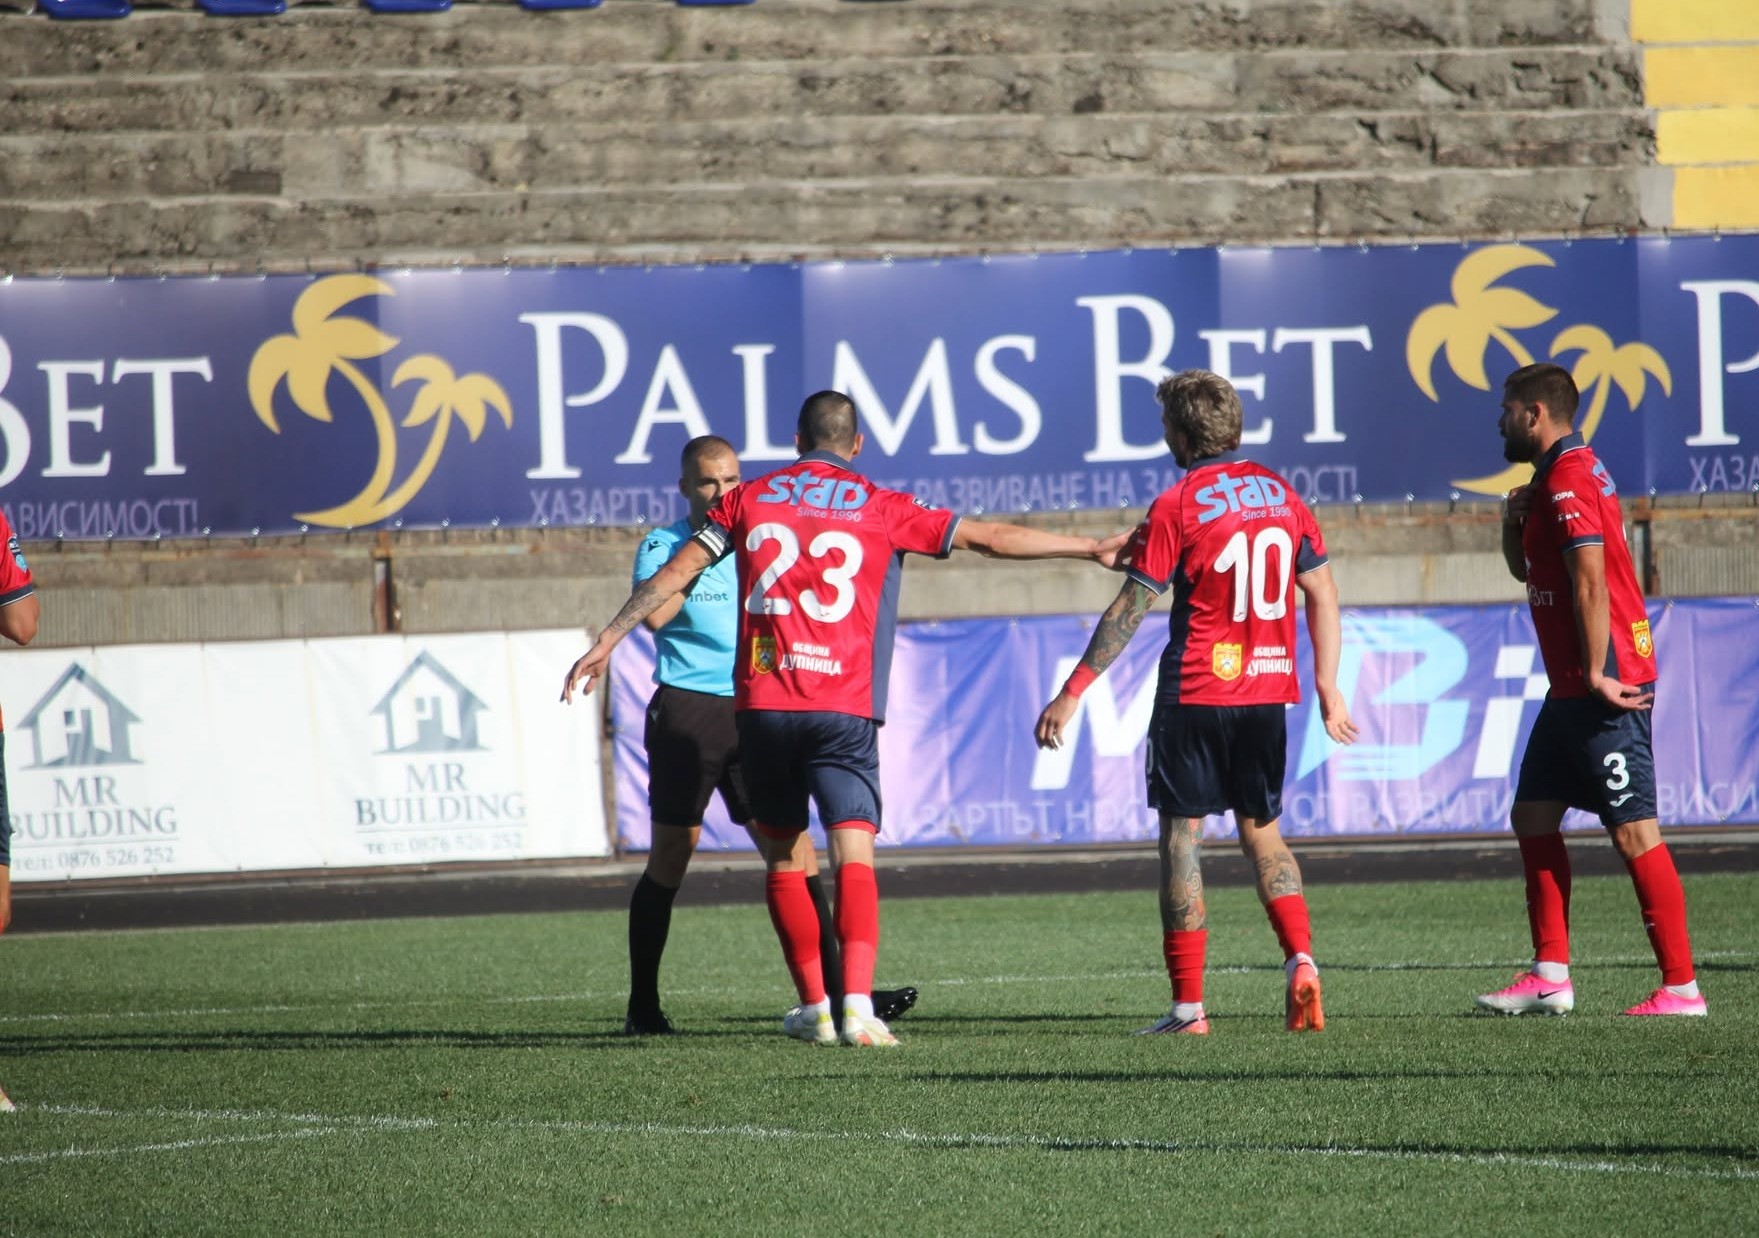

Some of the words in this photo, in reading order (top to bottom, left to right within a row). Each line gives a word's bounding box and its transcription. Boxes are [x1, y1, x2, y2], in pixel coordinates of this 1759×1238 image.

[518, 311, 1042, 480] PALMS
[1077, 294, 1372, 462] BET
[913, 471, 1087, 511] РАЗВИВАНЕ
[1091, 468, 1136, 508] НА
[796, 507, 827, 519] Since
[831, 510, 862, 522] 1990
[1242, 508, 1267, 521] Since
[744, 522, 864, 624] 23
[1213, 526, 1294, 623] 10
[779, 653, 842, 677] ДУПНИЦА
[792, 641, 830, 658] ОБЩИНА
[1252, 645, 1287, 659] ОБЩИНА
[1245, 658, 1293, 676] ДУПНИЦ
[406, 762, 470, 793] MR
[1603, 752, 1630, 791] 3
[53, 774, 120, 808] MR
[10, 805, 178, 841] BUILDING
[355, 791, 528, 826] BUILDING
[58, 850, 101, 869] 0876
[106, 849, 139, 867] 526
[143, 846, 176, 864] 252
